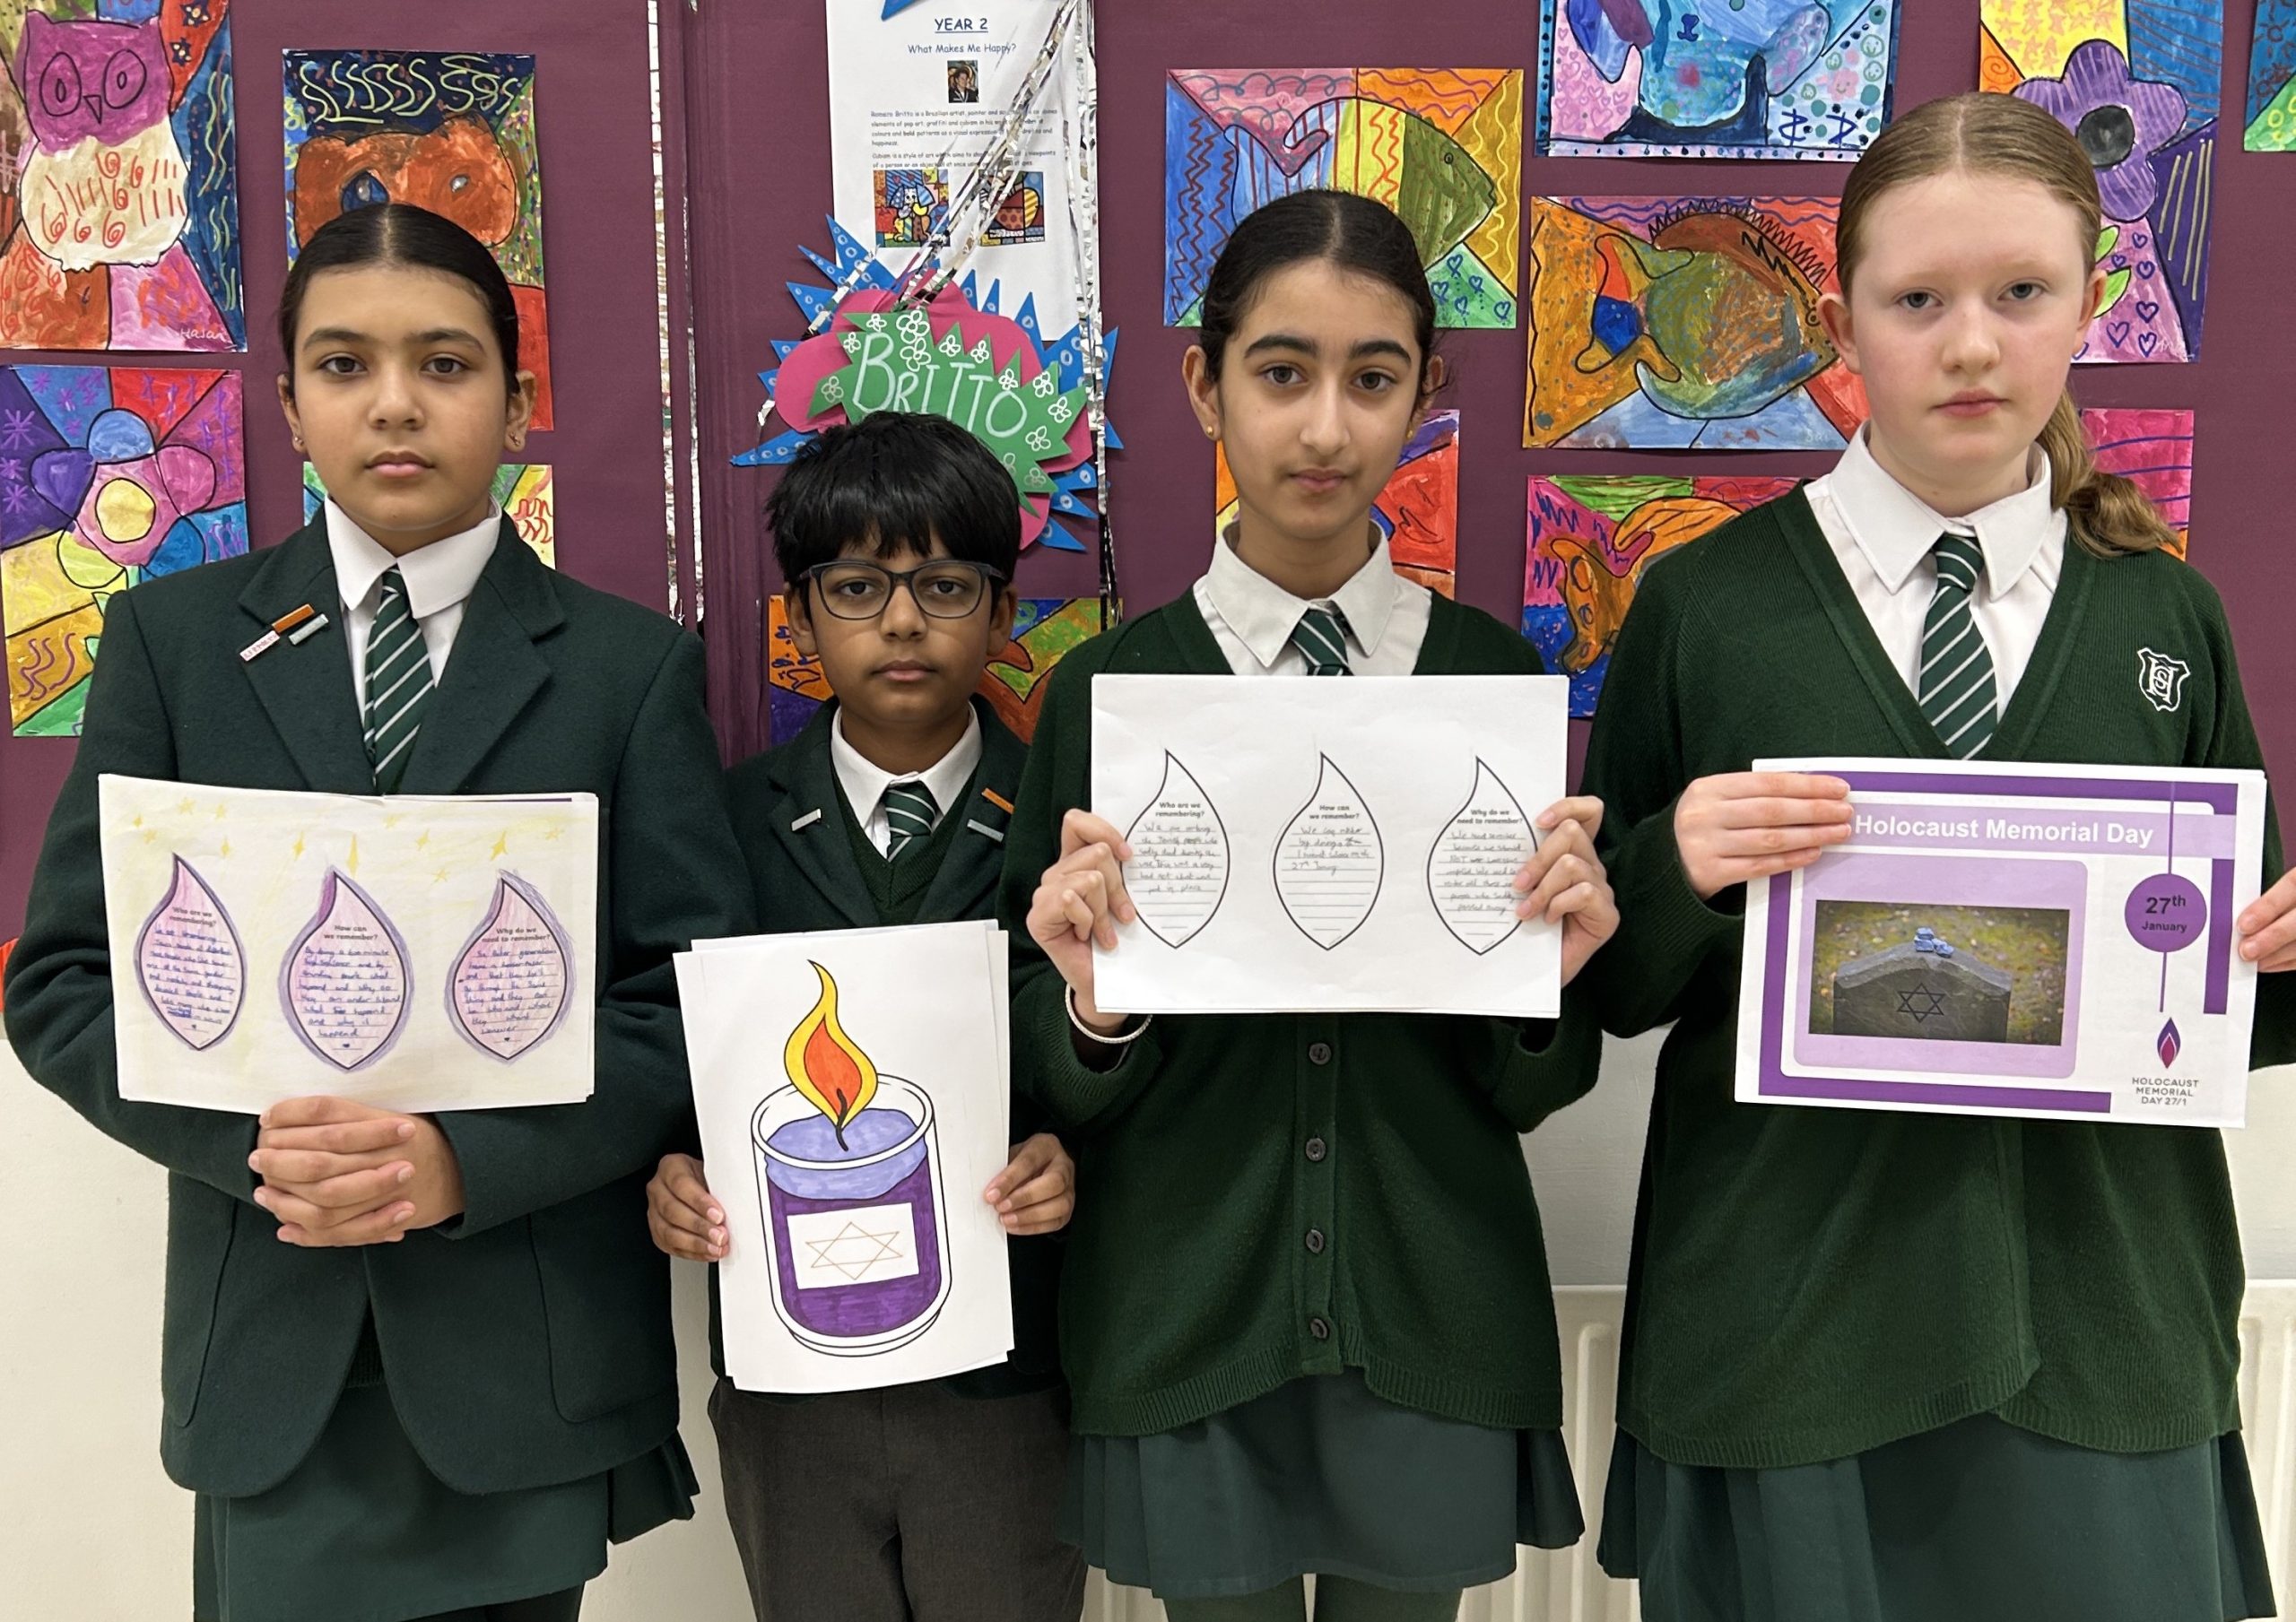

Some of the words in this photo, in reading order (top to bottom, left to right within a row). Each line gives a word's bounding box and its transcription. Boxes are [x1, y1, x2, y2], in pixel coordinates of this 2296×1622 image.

[935, 18, 972, 30] YEAR
[980, 18, 987, 30] 2
[908, 45, 932, 53] What
[935, 45, 963, 53] Makes
[968, 44, 980, 52] Me
[985, 43, 1016, 54] Happy?
[1155, 811, 1205, 819] remembering?
[1855, 814, 1979, 838] Holocaust
[1987, 819, 2099, 843] Memorial
[2107, 823, 2153, 849] Day
[2145, 894, 2187, 914] 27th
[2142, 921, 2187, 933] January
[2132, 1077, 2199, 1087] HOLOCAUST
[2136, 1087, 2194, 1097] MEMORIAL
[2165, 1097, 2187, 1106] 27/1
